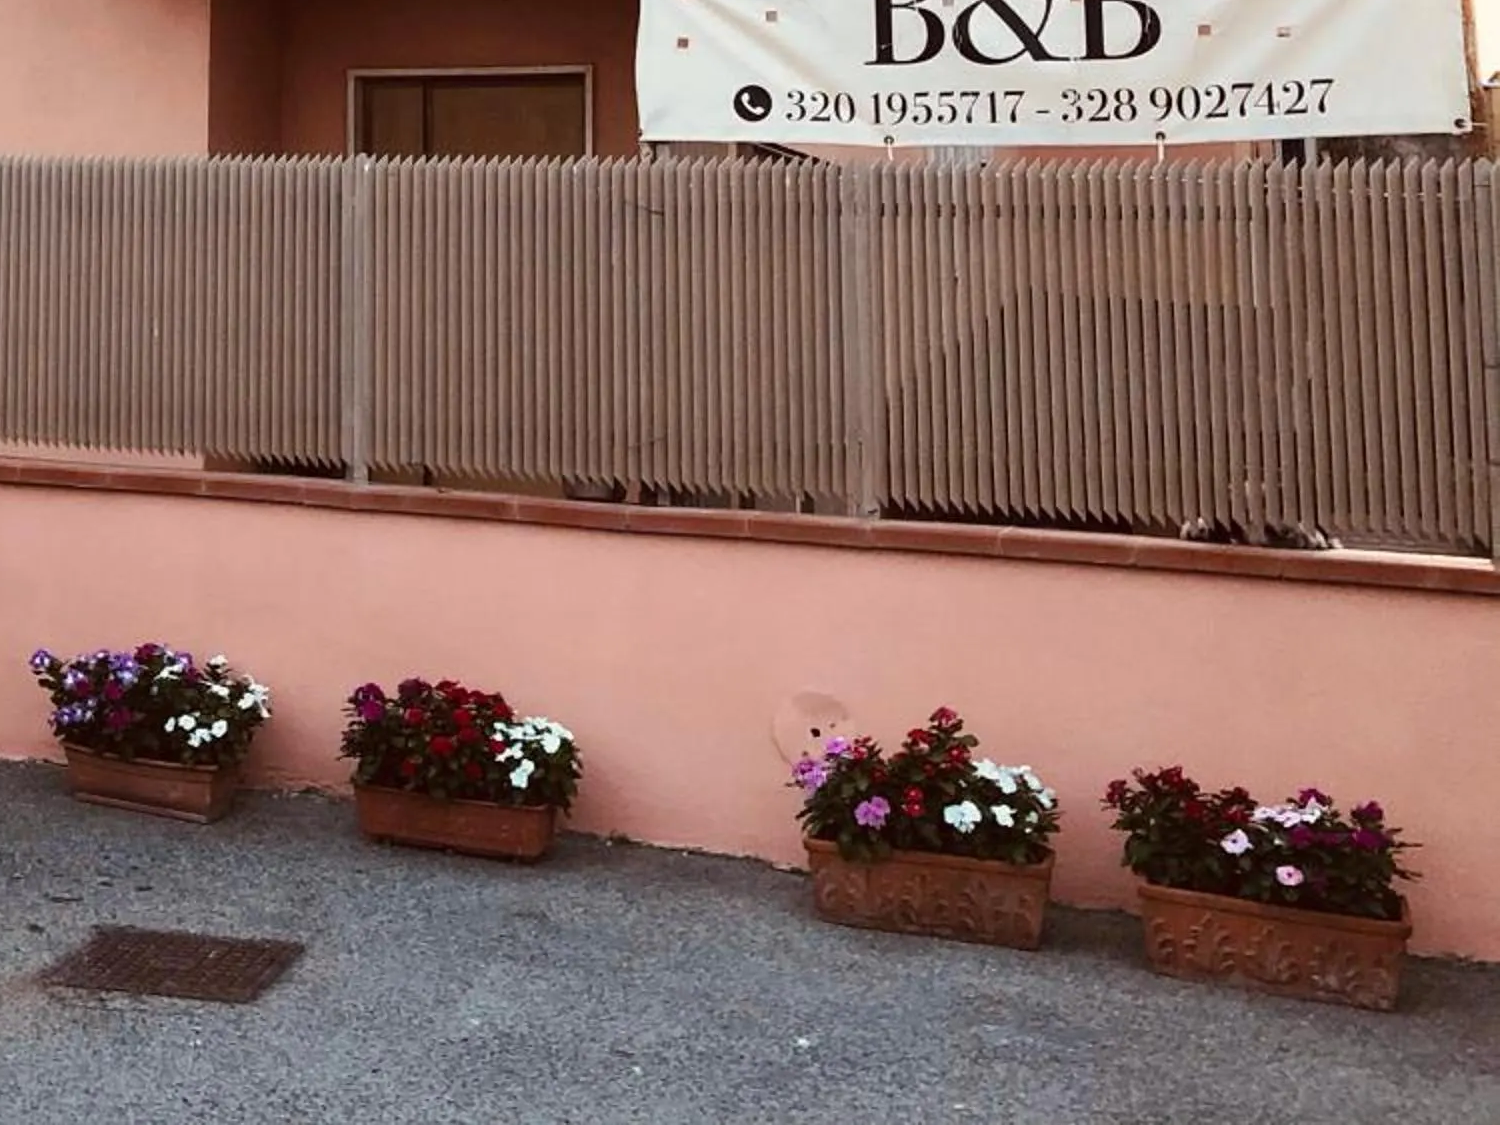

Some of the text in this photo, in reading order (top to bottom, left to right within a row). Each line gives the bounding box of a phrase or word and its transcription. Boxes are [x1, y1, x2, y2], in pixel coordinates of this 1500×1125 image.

[785, 90, 856, 124] 320
[871, 89, 1026, 125] 1955717
[1060, 87, 1138, 124] 328
[1148, 78, 1335, 122] 9027427
